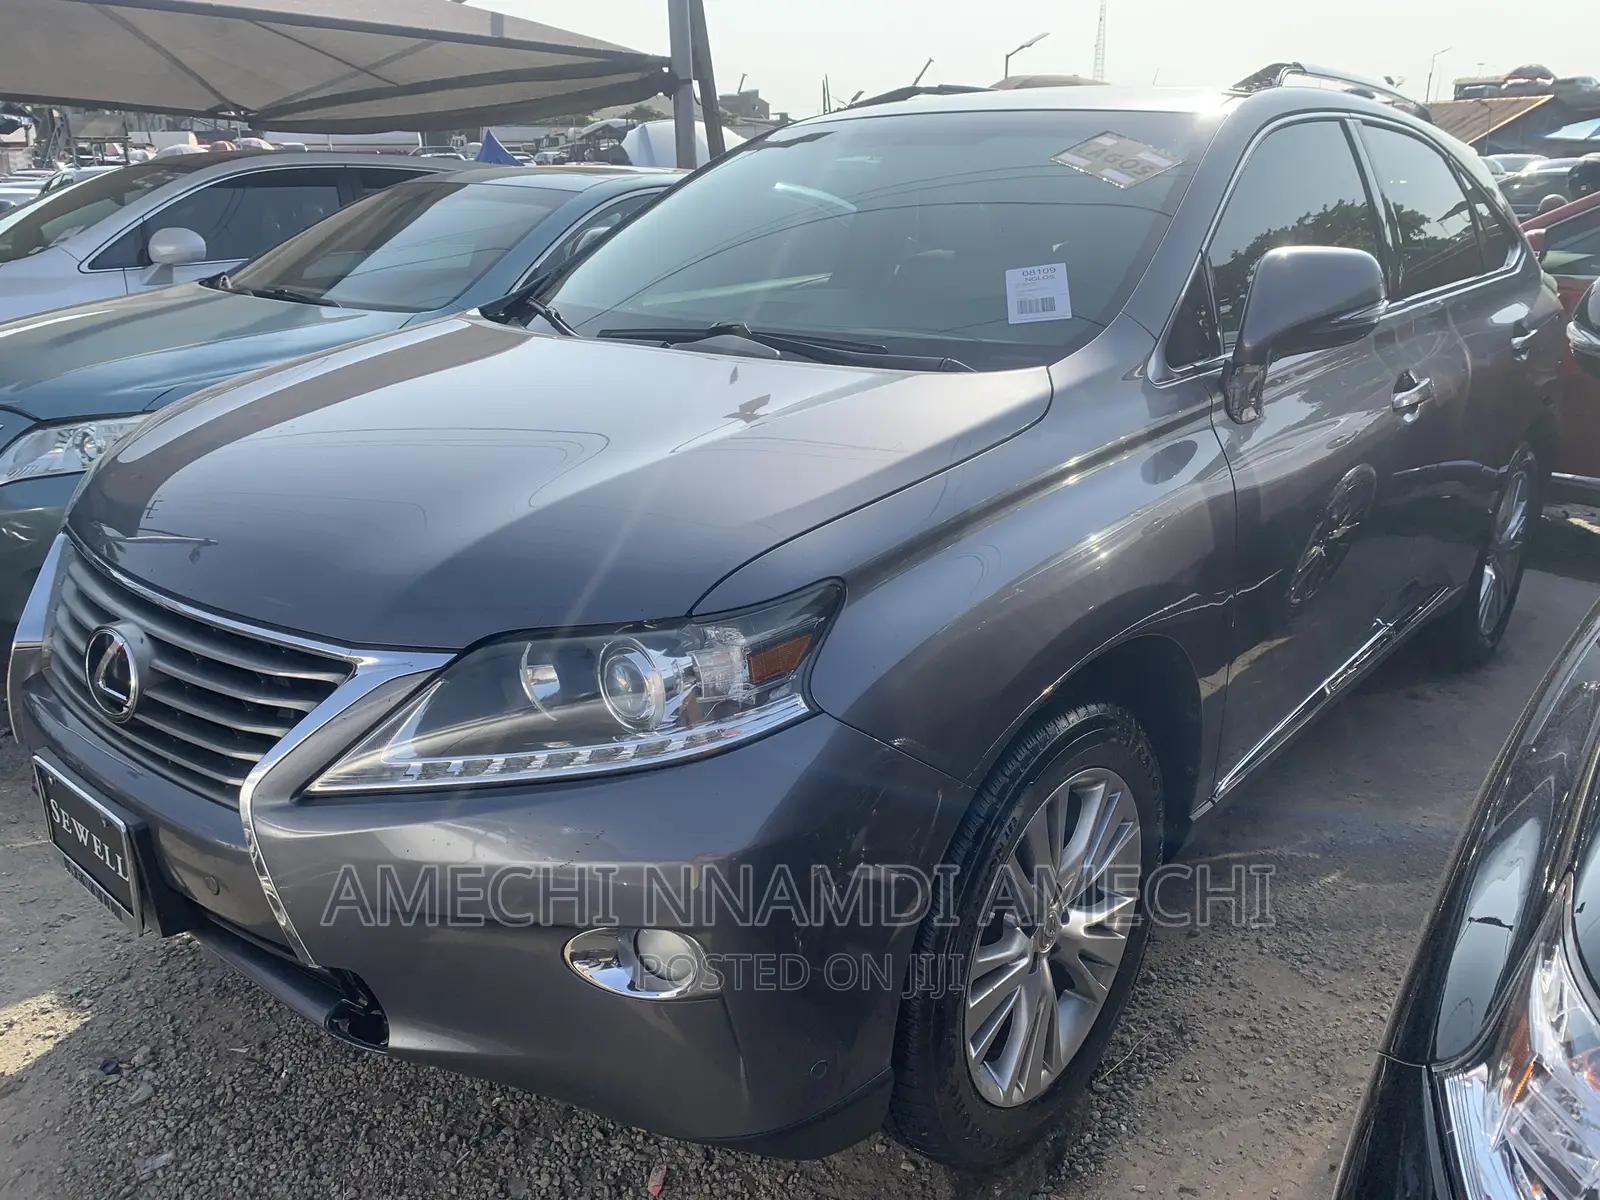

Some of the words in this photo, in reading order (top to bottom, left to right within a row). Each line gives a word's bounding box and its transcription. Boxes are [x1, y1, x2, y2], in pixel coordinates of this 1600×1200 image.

[1075, 143, 1155, 176] LAGOS
[1022, 266, 1056, 277] 08109
[50, 798, 130, 882] SEWELL
